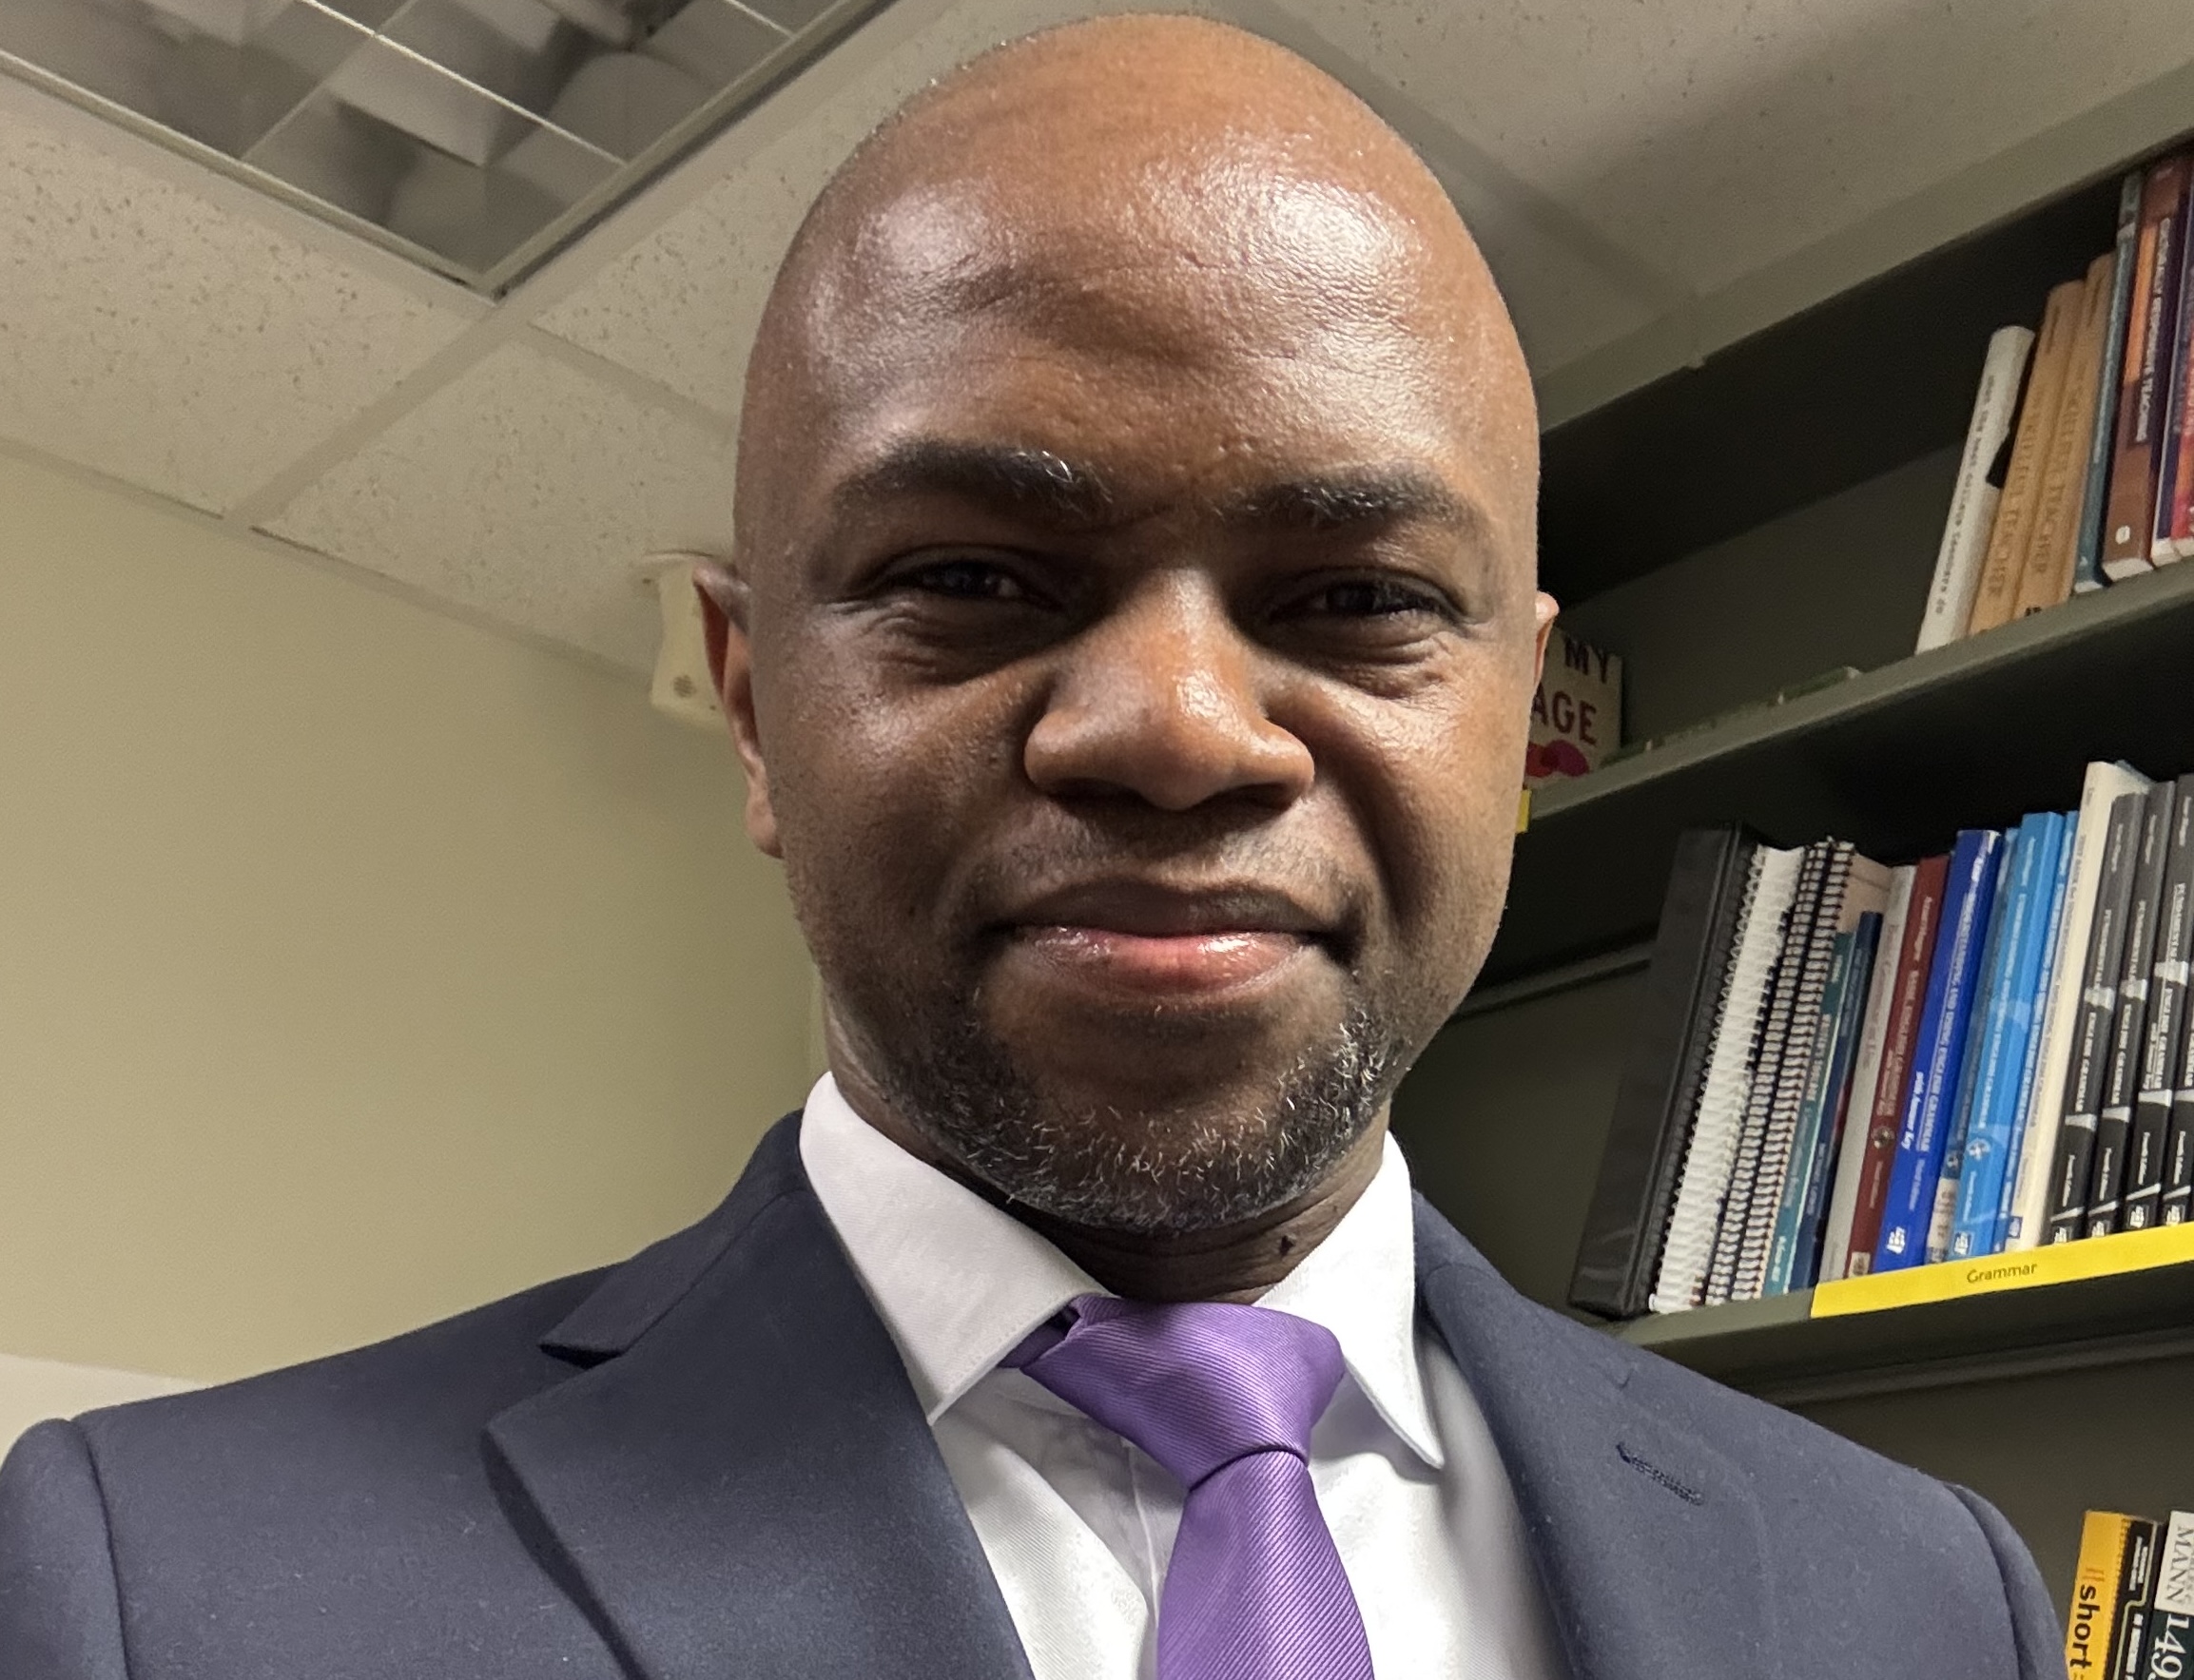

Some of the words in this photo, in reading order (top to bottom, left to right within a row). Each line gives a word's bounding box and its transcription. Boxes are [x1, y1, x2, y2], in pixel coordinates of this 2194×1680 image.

[1564, 635, 1610, 684] MY
[1967, 1264, 2037, 1284] Grammar
[2166, 1525, 2194, 1602] MANN
[2069, 1584, 2100, 1670] short
[2147, 1612, 2190, 1680] 149
